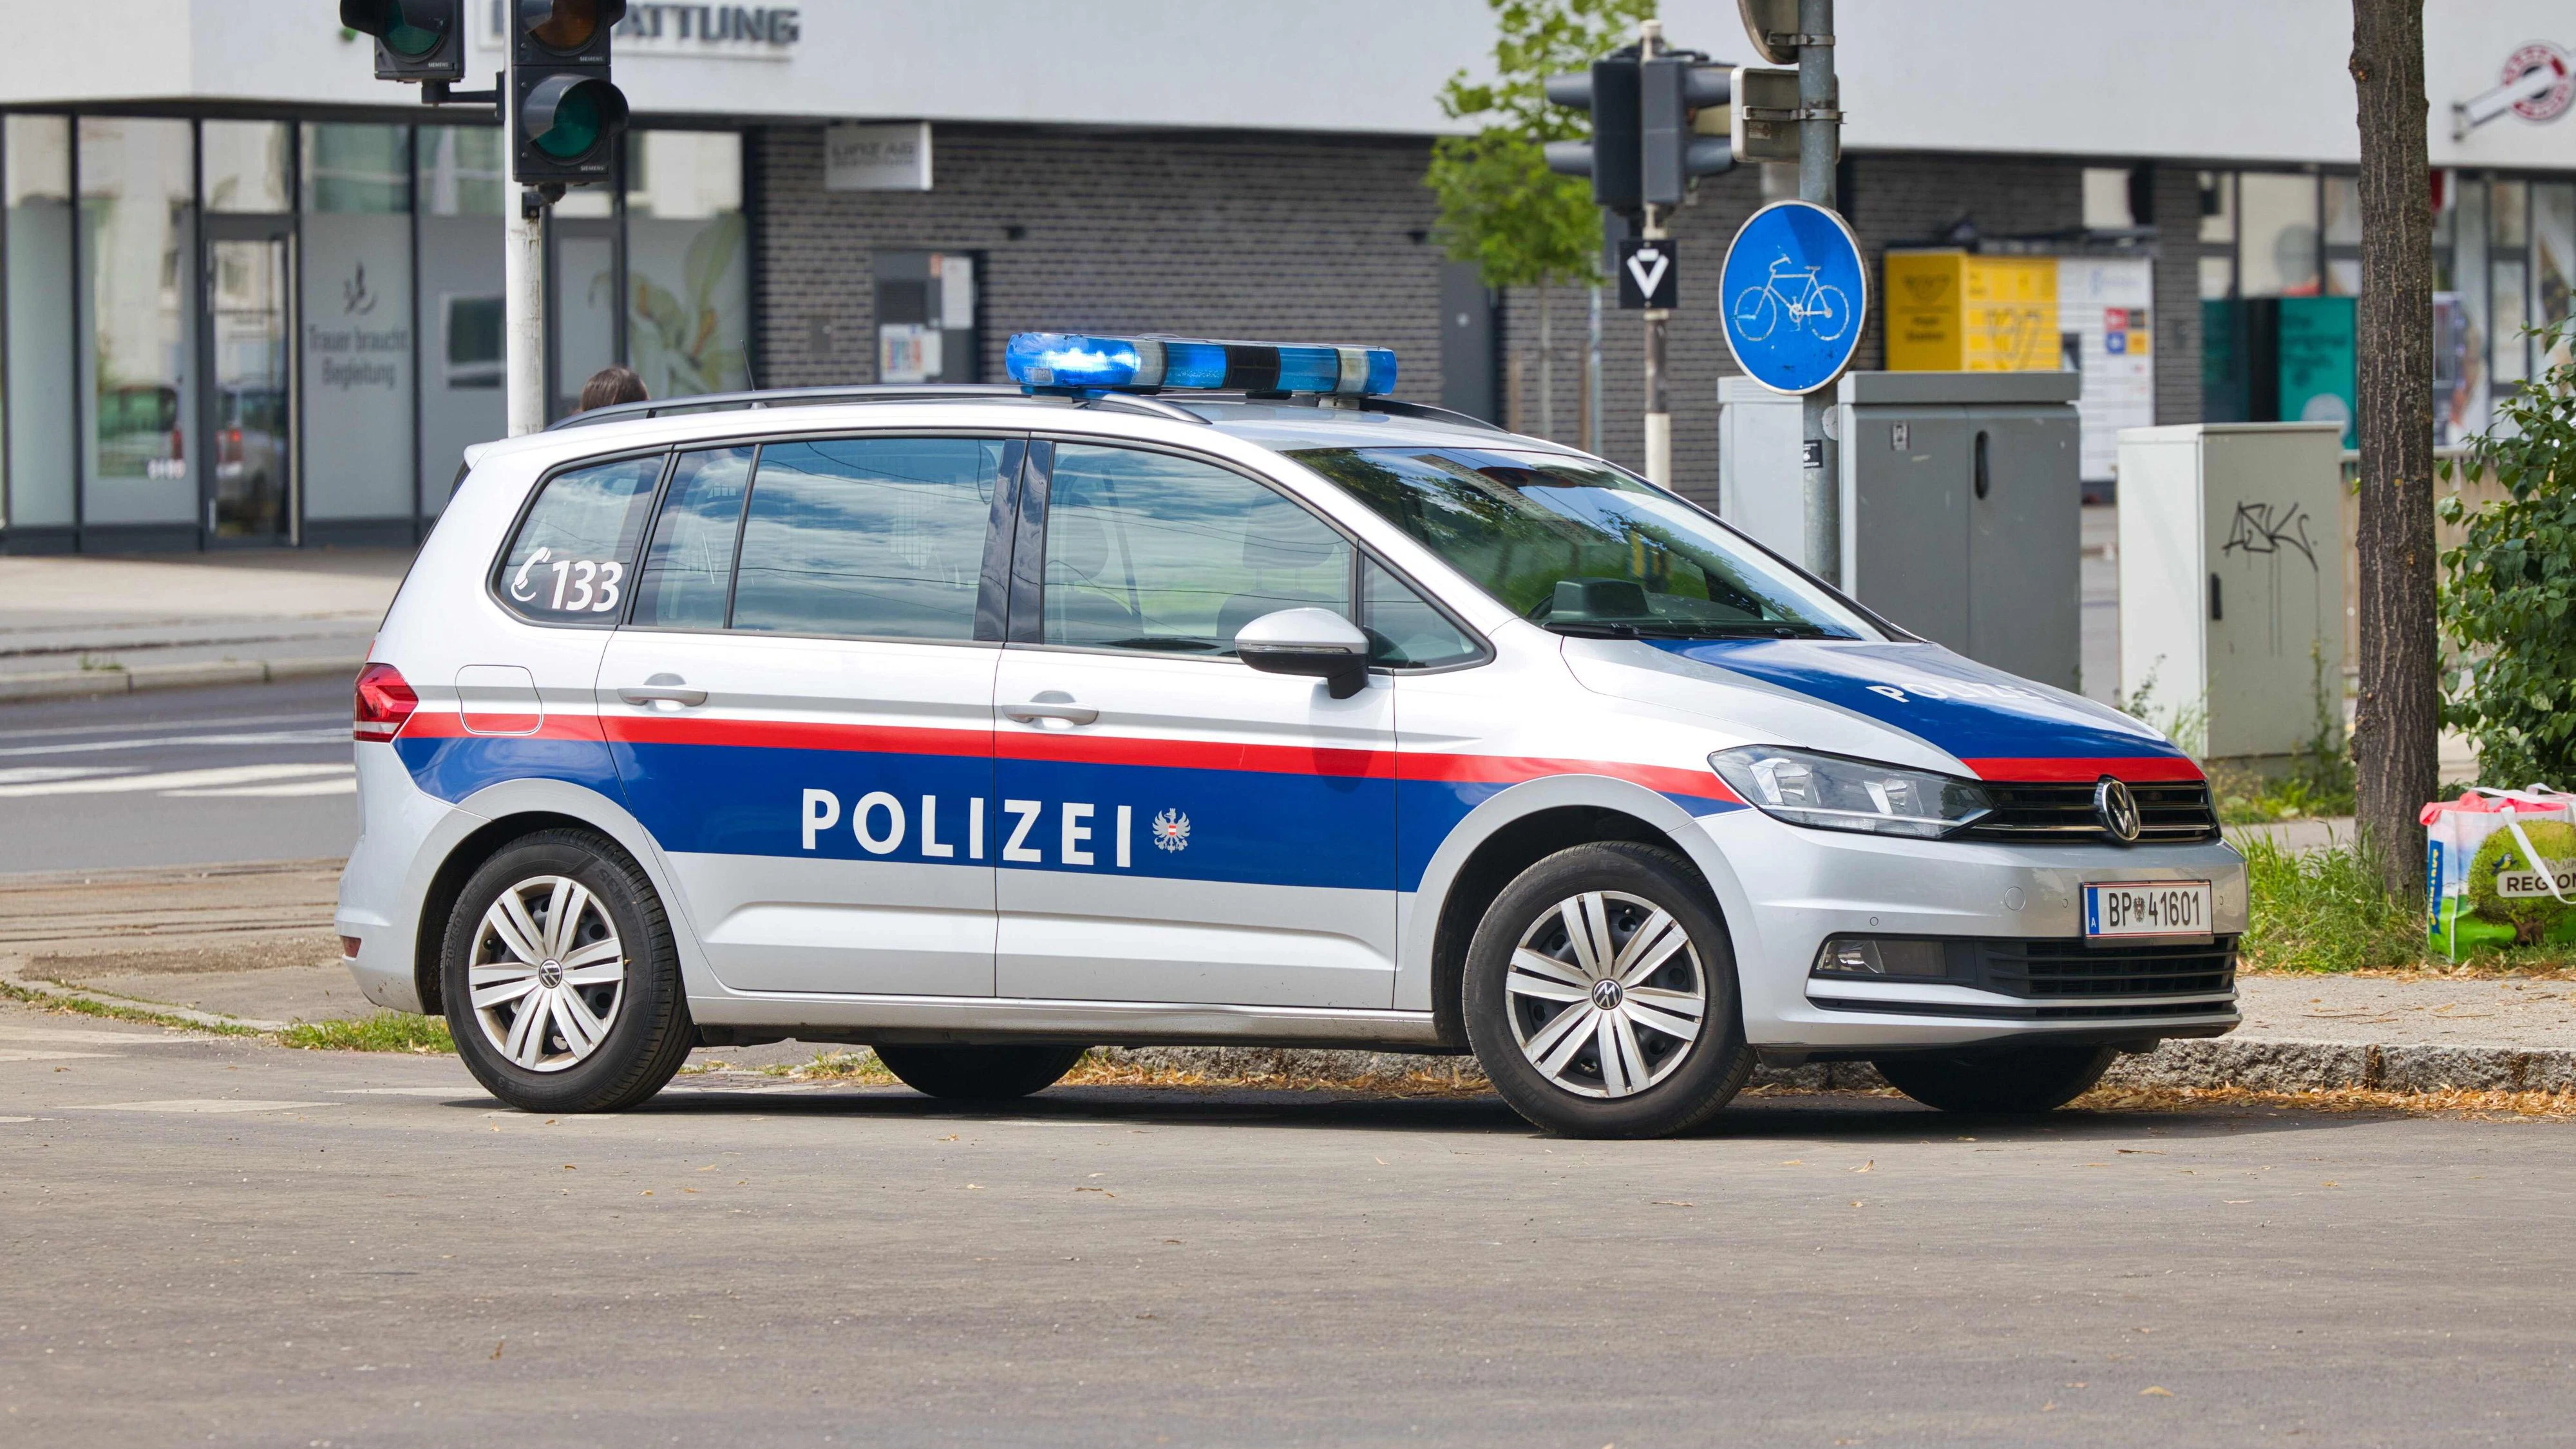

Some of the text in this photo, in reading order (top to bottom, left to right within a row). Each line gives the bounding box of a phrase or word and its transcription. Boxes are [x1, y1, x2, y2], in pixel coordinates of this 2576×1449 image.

[308, 323, 410, 353] Trauer braucht
[322, 356, 396, 391] Begleitung
[551, 560, 623, 612] 133
[1866, 683, 2061, 703] POLIZEI
[802, 788, 1132, 868] POLIZEI
[2506, 873, 2576, 892] REGO
[2090, 916, 2097, 928] A
[2108, 891, 2200, 927] BP 41601
